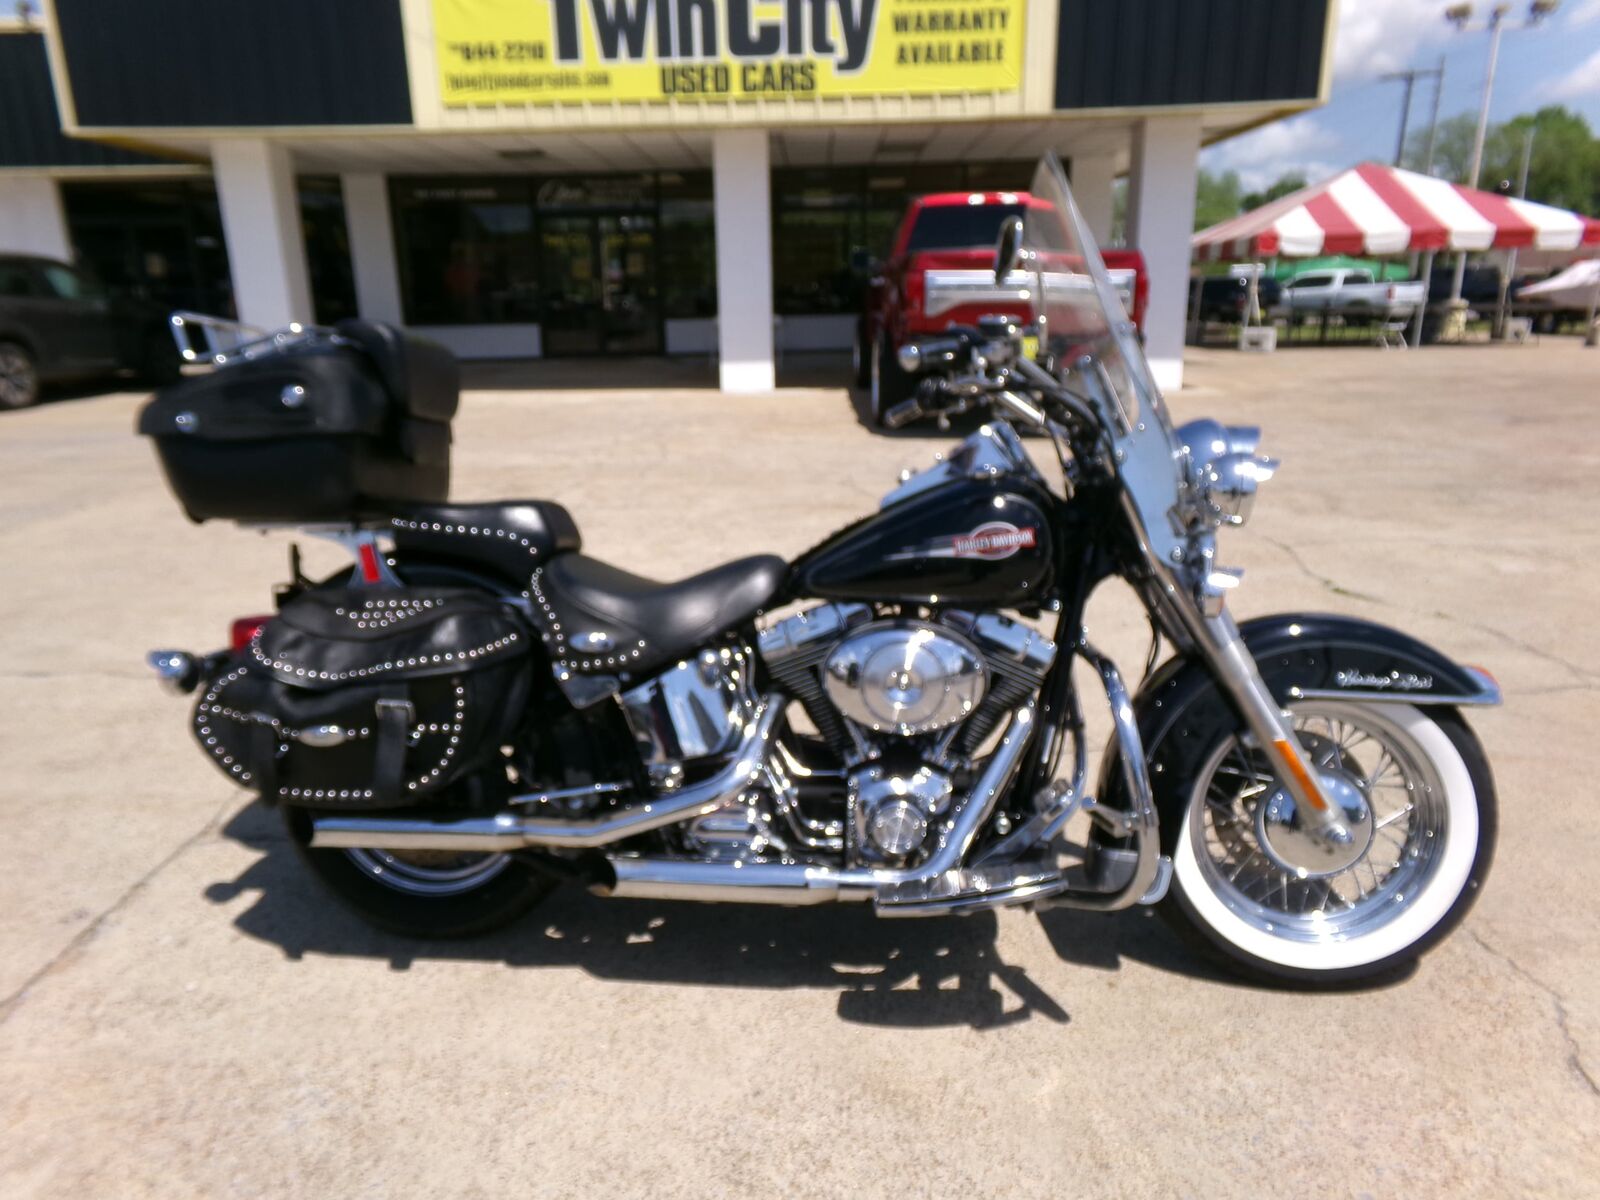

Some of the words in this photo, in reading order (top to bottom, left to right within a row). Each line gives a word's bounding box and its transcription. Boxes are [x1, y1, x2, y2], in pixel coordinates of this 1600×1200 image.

[893, 10, 1008, 32] WARRANTY
[896, 42, 1004, 64] AVAILABLE
[661, 65, 730, 94] USED
[742, 63, 815, 92] CARS
